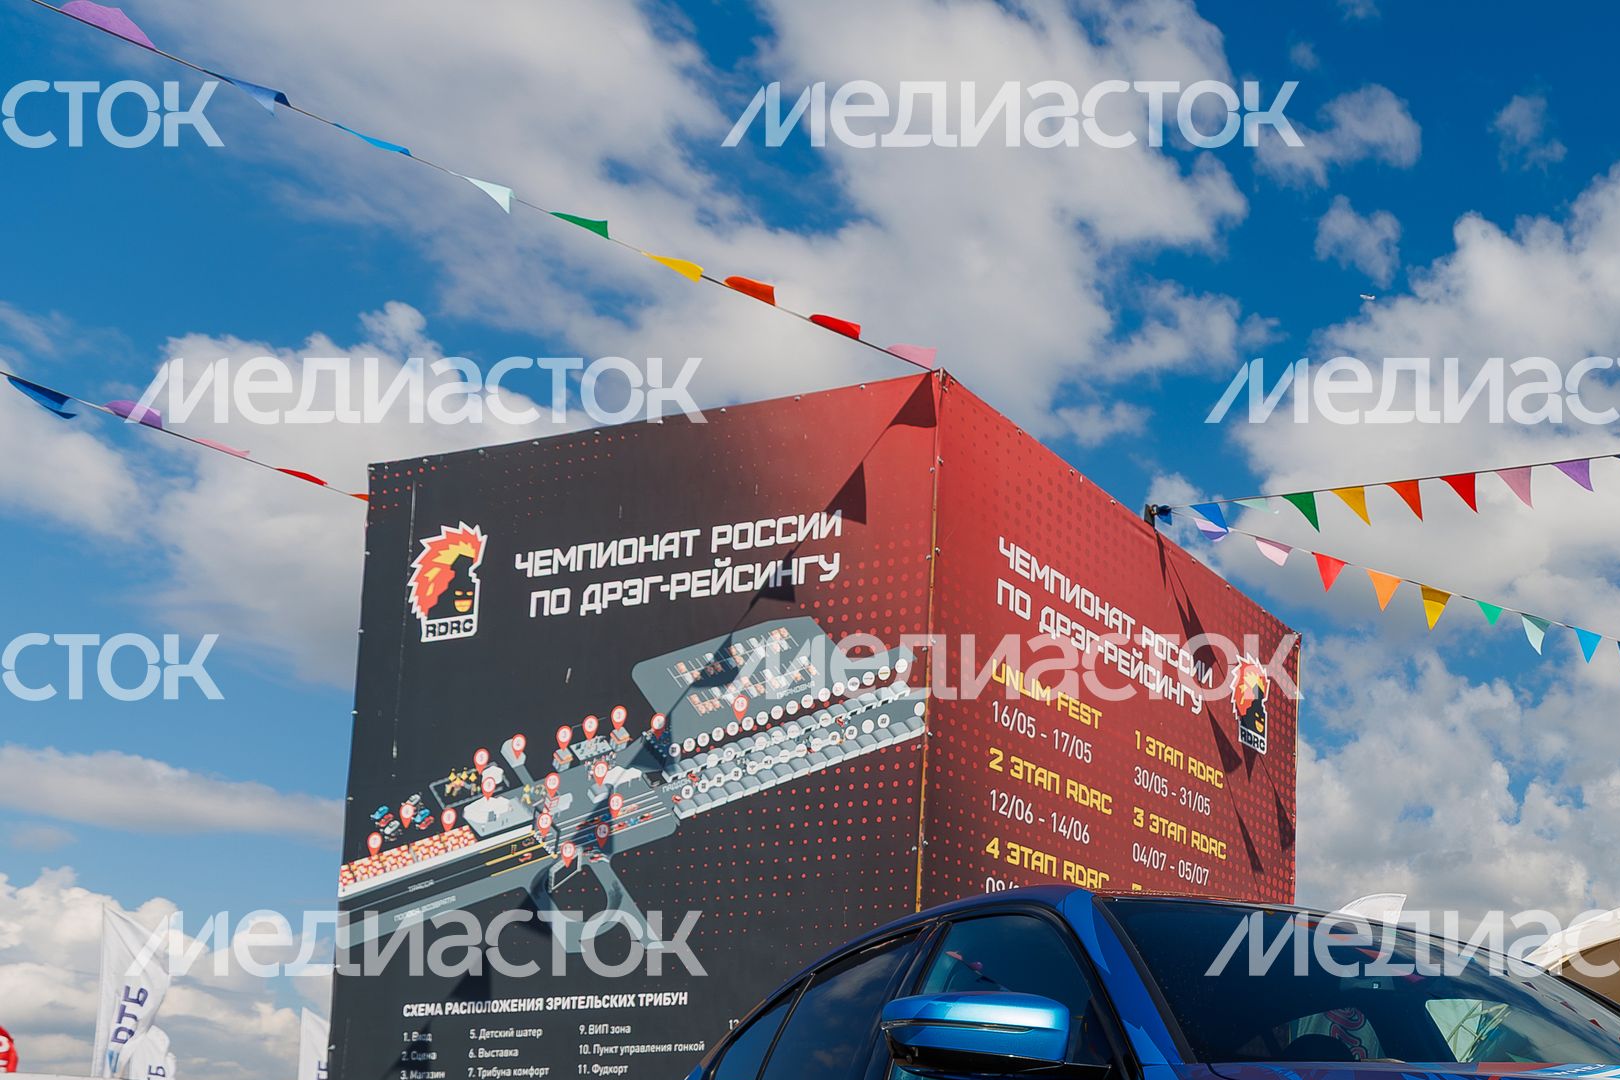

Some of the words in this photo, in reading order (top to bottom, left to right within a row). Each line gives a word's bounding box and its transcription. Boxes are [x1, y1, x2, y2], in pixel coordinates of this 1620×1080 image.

[514, 529, 699, 578] ЧЕМПИОНАТ
[711, 509, 842, 553] РОССИИ
[529, 584, 570, 618] ПО
[580, 552, 840, 617] ДРЭГ-РЕЙСИНГУ
[425, 619, 474, 638] RDRC
[999, 537, 1136, 638] ЧЕМПИОНАТ
[1141, 626, 1214, 688] РОССИИ
[996, 579, 1032, 620] ПО
[1039, 606, 1203, 715] ДРЭГ-РЕЙСИНГУ
[992, 659, 1052, 706] UNLIM
[1057, 690, 1103, 730] FEST
[991, 702, 1037, 740] 16/05
[1052, 727, 1092, 764] 17/05
[988, 748, 1003, 774] 2
[1010, 755, 1060, 796] ЭТАП
[1066, 778, 1113, 816] RDRC
[1134, 730, 1141, 750] 1
[1145, 735, 1184, 768] ЭТАП
[1188, 754, 1224, 789] RDRC
[1134, 766, 1168, 799] 30/05
[1179, 785, 1211, 816] 31/05
[989, 788, 1034, 826] 12/06
[1050, 811, 1090, 845] 14/06
[1132, 806, 1144, 829] 3
[1148, 812, 1187, 845] ЭТАП
[1191, 830, 1227, 860] RDRC
[985, 836, 1000, 860] 4
[1006, 842, 1057, 878] ЭТАП
[1132, 843, 1167, 874] 04/07
[1177, 858, 1209, 887] 05/07
[402, 1001, 443, 1017] СХЕМА
[444, 997, 544, 1016] РАСПОЛОЖЕНИЯ
[545, 994, 635, 1012] ЗРИТЕЛЬСКИХ
[637, 991, 689, 1008] ТРИБУН
[588, 1023, 609, 1035] ВИП
[610, 1024, 632, 1035] зона
[477, 1047, 519, 1059] Выставка
[478, 1027, 514, 1041] Детский
[516, 1028, 543, 1040] шатер
[592, 1043, 618, 1055] Пункт
[619, 1042, 672, 1056] управления
[673, 1040, 705, 1053] гонкой
[477, 1065, 510, 1080] Трибуна
[511, 1065, 550, 1079] комфорт
[591, 1062, 628, 1077] Фудкорт
